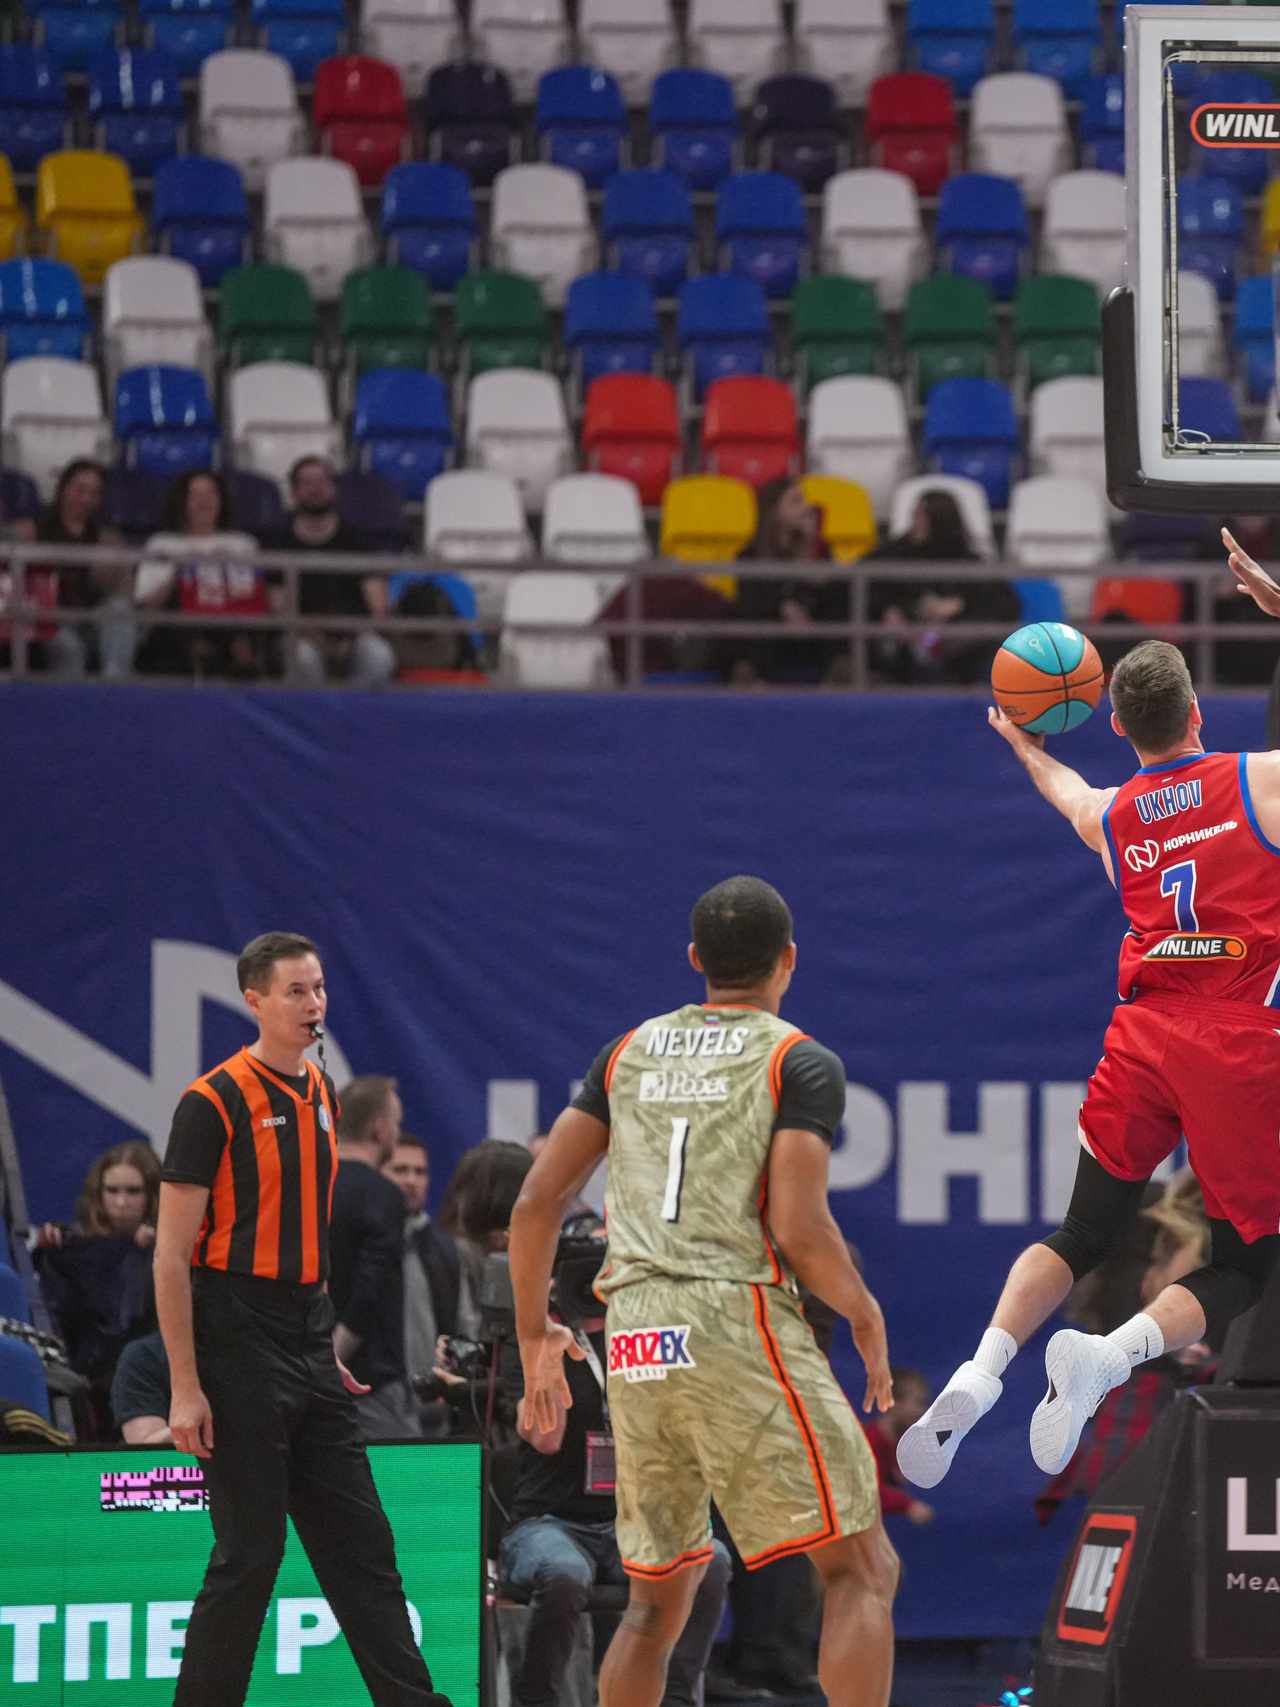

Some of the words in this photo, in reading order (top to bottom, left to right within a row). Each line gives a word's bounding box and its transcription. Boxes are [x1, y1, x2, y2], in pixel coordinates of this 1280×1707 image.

[1134, 779, 1202, 825] UKHOV
[1163, 820, 1238, 853] НОРНИКЕЛЬ
[1160, 859, 1199, 933] 7
[646, 1026, 751, 1058] NEVELS
[667, 1069, 731, 1096] Робек
[661, 1117, 690, 1224] 1
